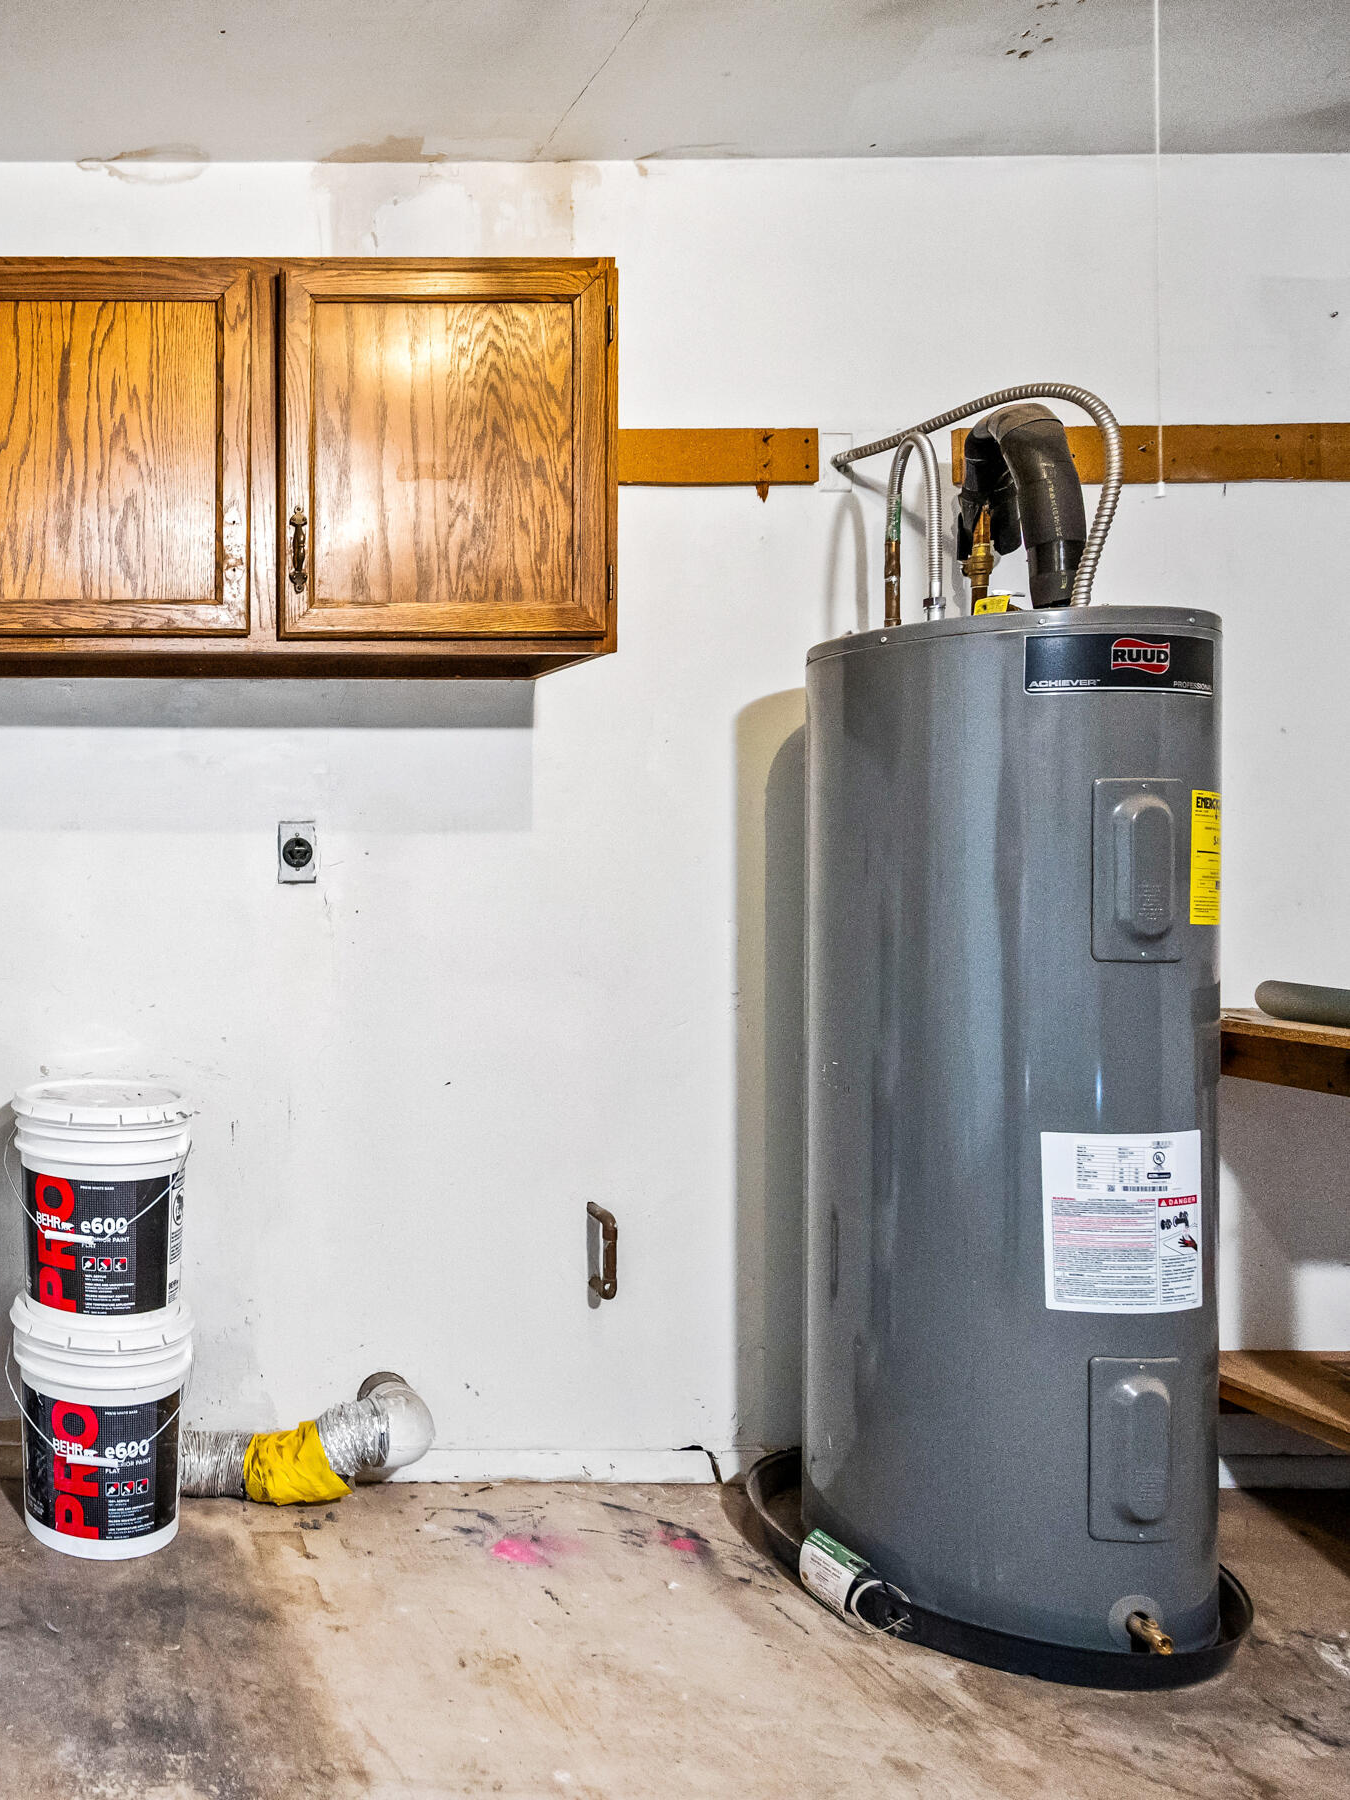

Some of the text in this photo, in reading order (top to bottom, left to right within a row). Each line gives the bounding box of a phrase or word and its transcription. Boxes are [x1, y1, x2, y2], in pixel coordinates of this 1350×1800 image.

[1112, 649, 1169, 663] RUUD
[1173, 681, 1213, 691] PROFESSIONAL
[1168, 1197, 1196, 1206] DANGER
[36, 1211, 61, 1230] BEHR
[80, 1217, 128, 1235] e600
[35, 1173, 76, 1313] PRO
[52, 1437, 84, 1456] BEHR
[104, 1439, 150, 1459] e600
[51, 1400, 100, 1540] PRO
[135, 1457, 152, 1466] PAINT
